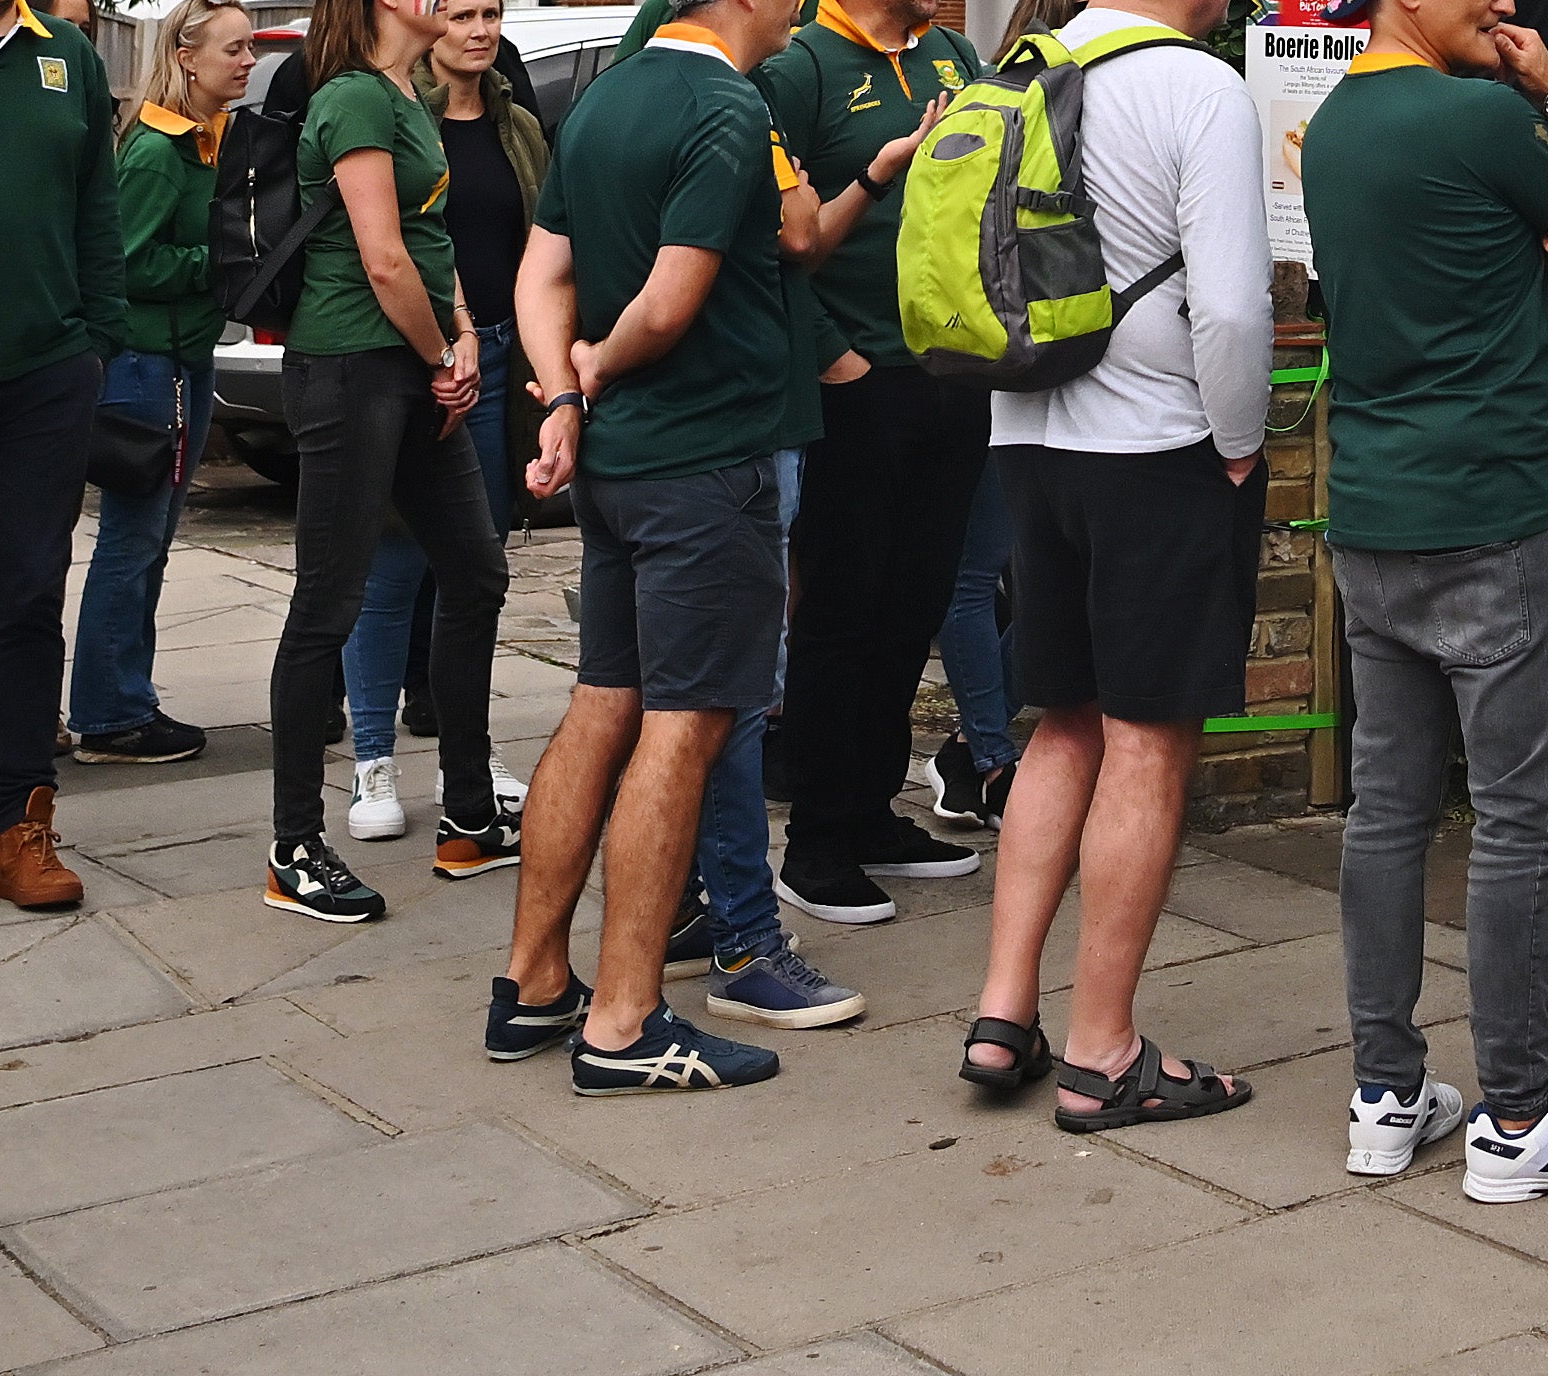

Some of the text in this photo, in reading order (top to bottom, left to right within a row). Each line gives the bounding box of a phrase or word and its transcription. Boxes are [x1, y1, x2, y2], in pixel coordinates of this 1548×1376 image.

[1299, 1, 1328, 11] BILTON
[1265, 33, 1364, 60] Boerie Rolls
